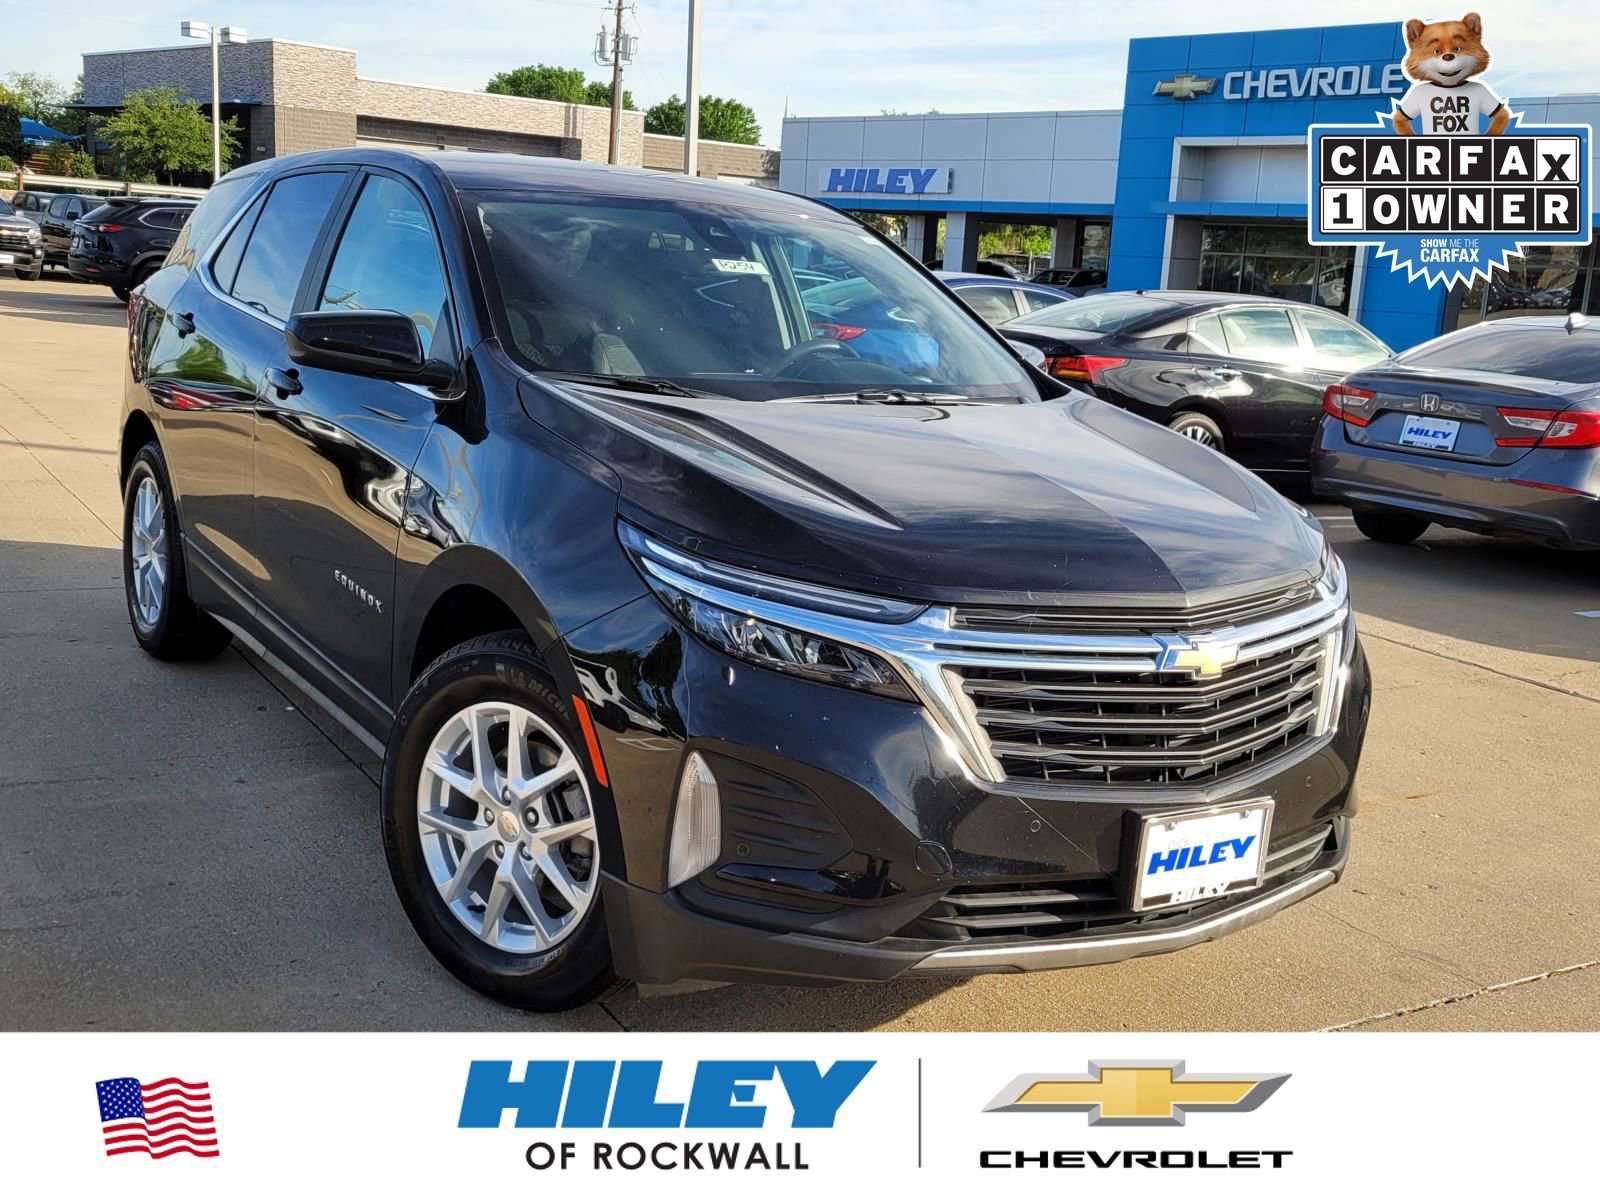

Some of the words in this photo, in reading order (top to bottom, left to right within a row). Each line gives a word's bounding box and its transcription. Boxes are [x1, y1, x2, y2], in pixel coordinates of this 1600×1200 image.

[1223, 63, 1404, 100] CHEVROLE
[827, 168, 937, 193] HILEY
[1407, 427, 1453, 439] HILEY
[334, 569, 382, 614] EQUINOX
[1147, 835, 1256, 875] HILEY
